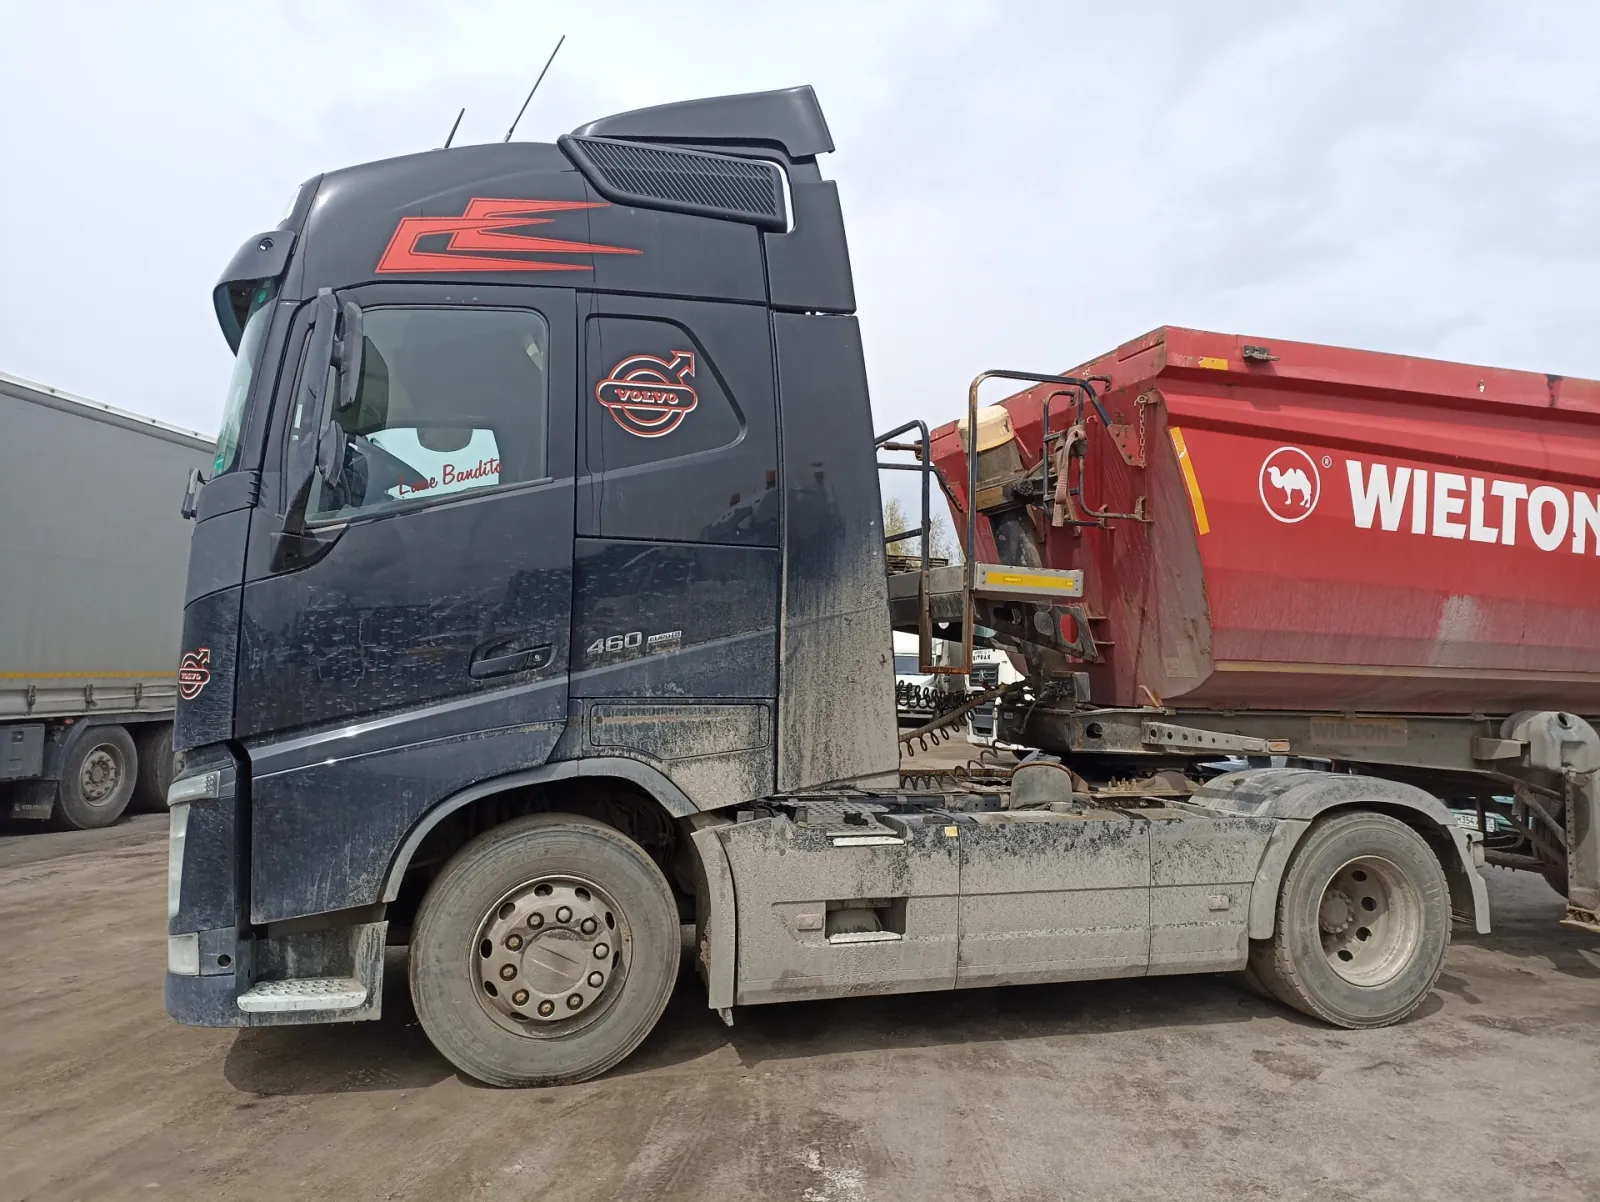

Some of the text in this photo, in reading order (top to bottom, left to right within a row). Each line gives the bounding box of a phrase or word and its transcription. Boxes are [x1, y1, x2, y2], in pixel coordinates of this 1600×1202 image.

[614, 388, 679, 404] VOLVO
[442, 457, 503, 486] Bandito
[1345, 459, 1600, 557] WIELTON
[586, 631, 642, 654] 460
